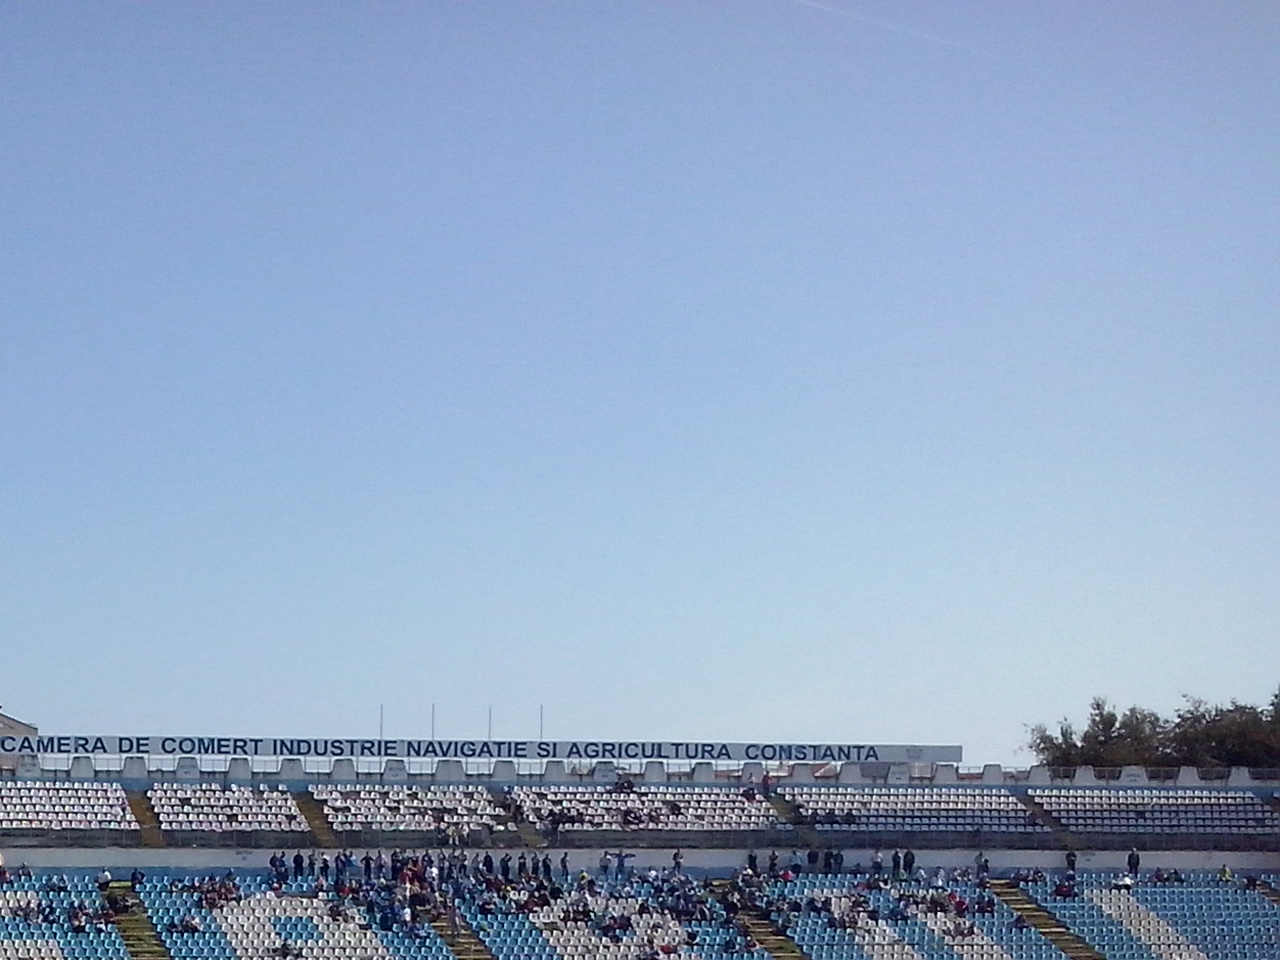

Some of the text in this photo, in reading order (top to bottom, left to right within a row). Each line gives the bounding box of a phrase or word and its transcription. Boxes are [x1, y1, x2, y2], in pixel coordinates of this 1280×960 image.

[0, 736, 879, 761] CAMERA DE COMERT INDUSTRIE NAVIGATIE SI AGRICULTURA CONSTANTA
